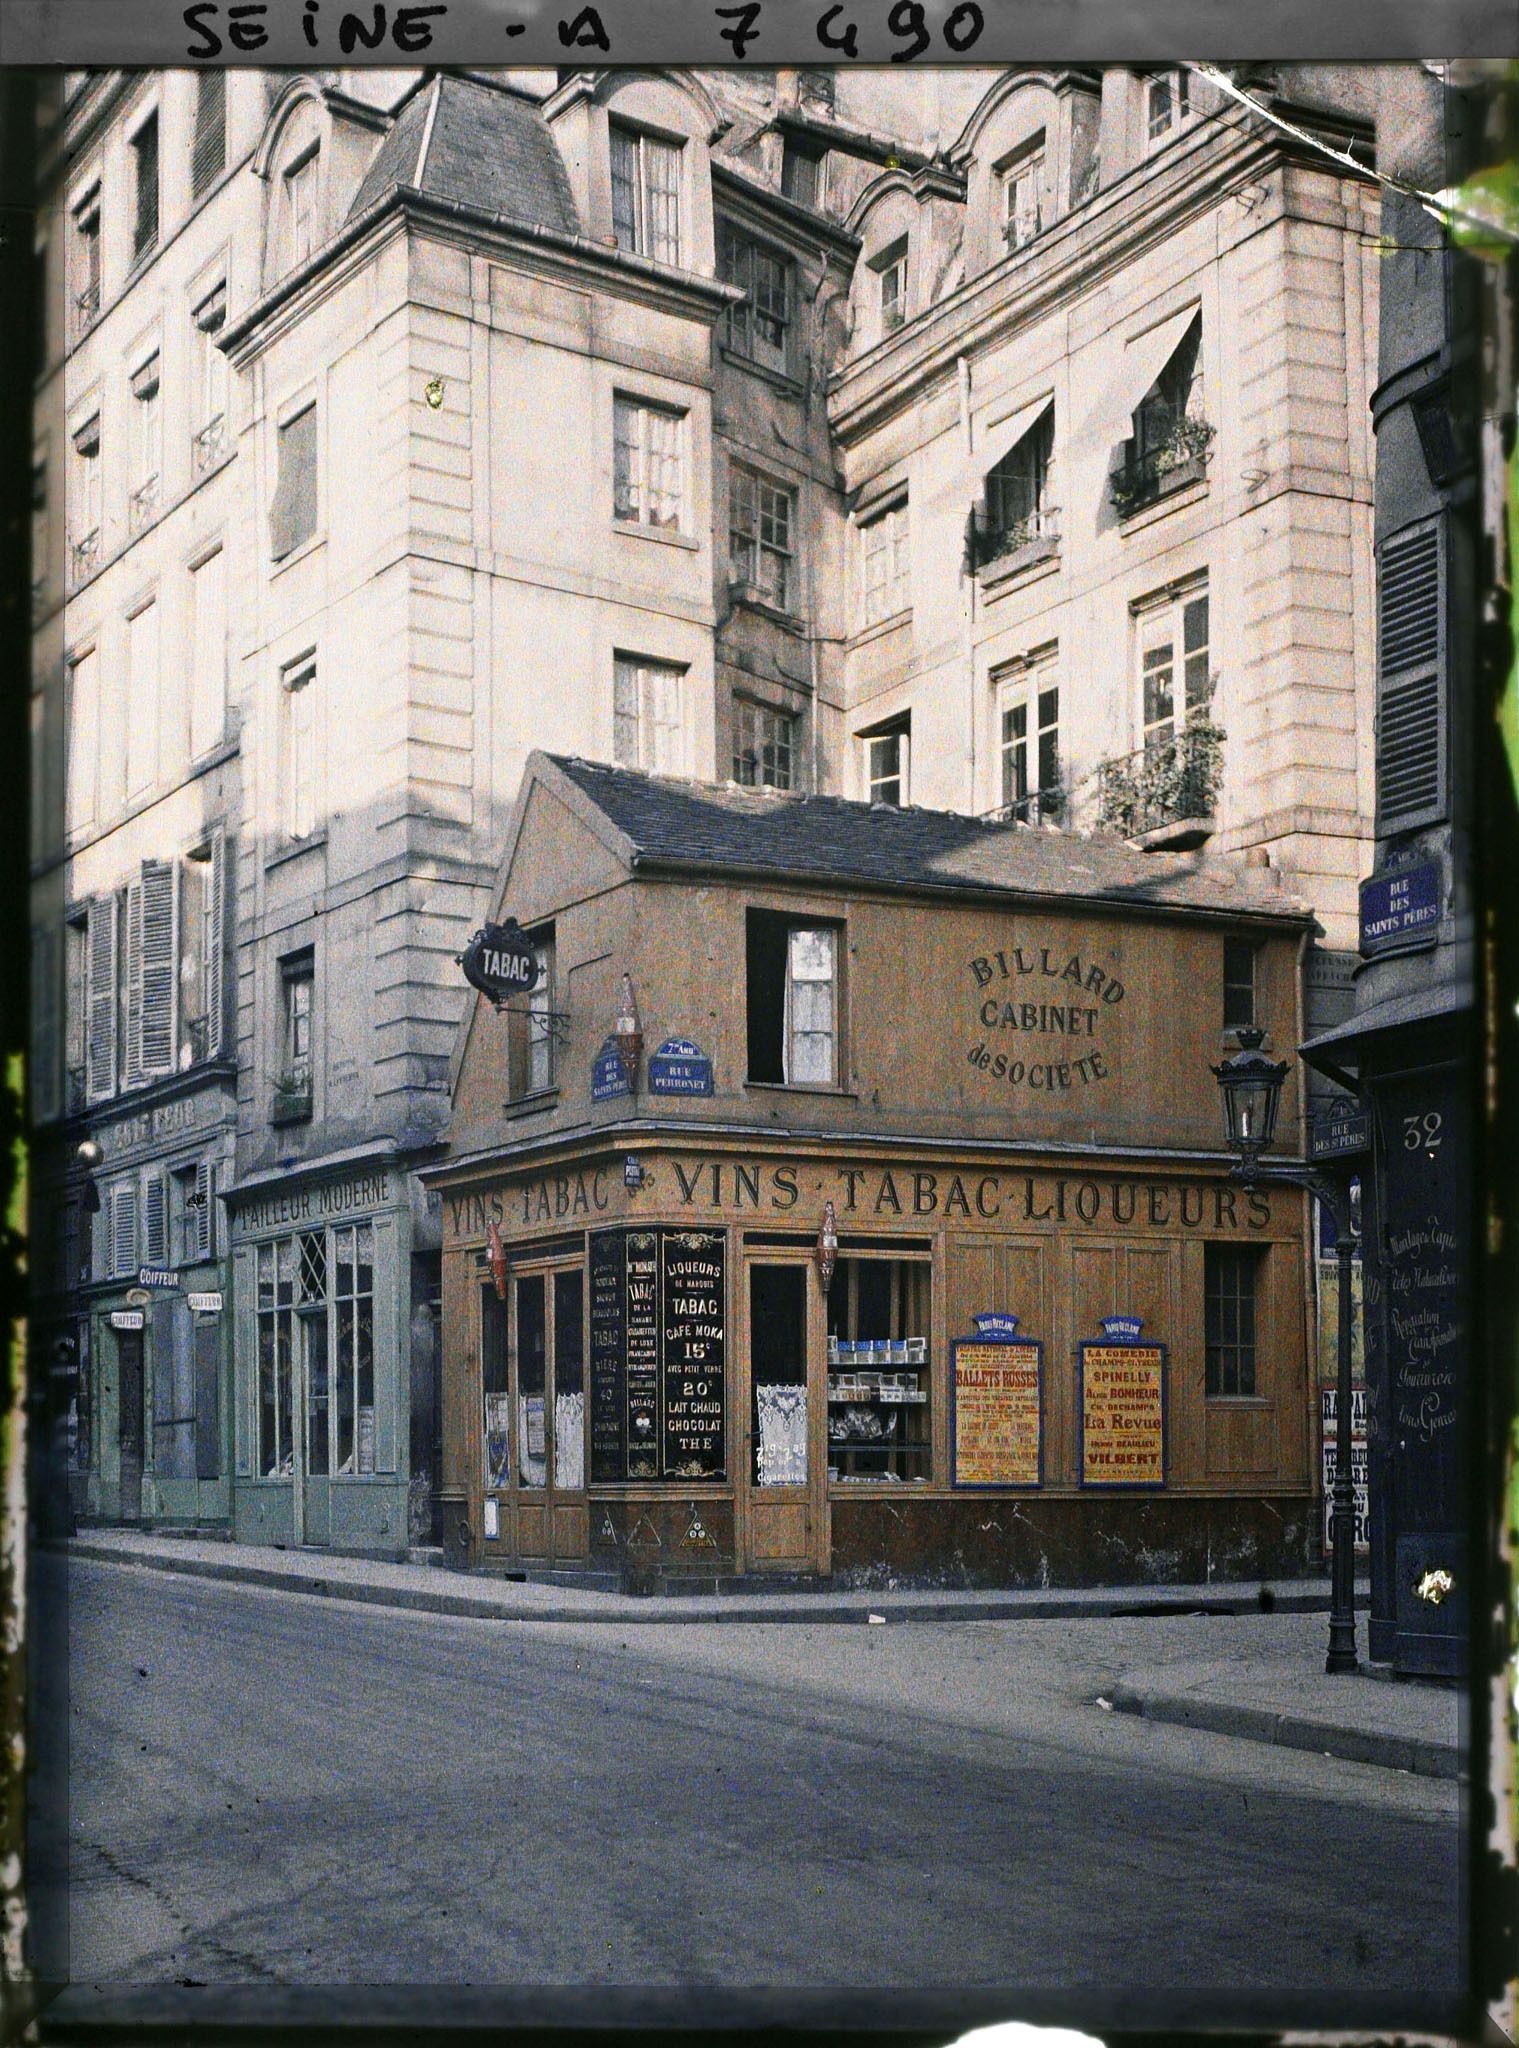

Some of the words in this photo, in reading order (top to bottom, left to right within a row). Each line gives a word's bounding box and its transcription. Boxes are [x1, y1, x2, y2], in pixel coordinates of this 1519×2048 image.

[1389, 878, 1410, 897] RUE
[1389, 897, 1410, 914] DES
[1363, 916, 1399, 937] SAINTS
[482, 947, 530, 984] TABAC
[969, 947, 1125, 1005] BILLARD
[979, 999, 1099, 1036] CABINET
[967, 1043, 991, 1070] de
[669, 1066, 692, 1076] RUE
[655, 1078, 706, 1090] PERRONET
[1331, 1122, 1349, 1136] RUE
[1403, 1112, 1442, 1150] 32
[242, 1190, 311, 1230] TAILLEUR
[319, 1173, 389, 1214] MODERNE
[450, 1190, 503, 1236] VINS
[521, 1167, 608, 1224] TABAC
[671, 1163, 799, 1209] VINS
[837, 1168, 1000, 1219] TABAC
[1022, 1177, 1272, 1229] LIQUEURS
[139, 1268, 179, 1285] COIFFEUR
[667, 1261, 721, 1278] LIQUEURS
[629, 1283, 655, 1301] TABAC
[672, 1298, 718, 1315] TABAC
[695, 1325, 723, 1340] MOKA
[1087, 1349, 1102, 1358] LA
[1105, 1350, 1158, 1358] COMEDIE
[667, 1365, 681, 1374] AVEC
[1093, 1371, 1151, 1383] SPINELLY
[956, 1369, 1000, 1388] BALLETS
[1002, 1369, 1038, 1388] RUSSES
[1110, 1388, 1159, 1400] BONHEUR
[630, 1399, 655, 1409] BILLARD
[668, 1402, 688, 1414] LAIT
[690, 1402, 721, 1414] CHAUD
[668, 1420, 721, 1431] CHOCOLAT
[1084, 1413, 1105, 1430] La
[1111, 1413, 1161, 1430] Revue
[1116, 1440, 1155, 1448] BEAULIEU
[1087, 1453, 1159, 1465] VILBERT
